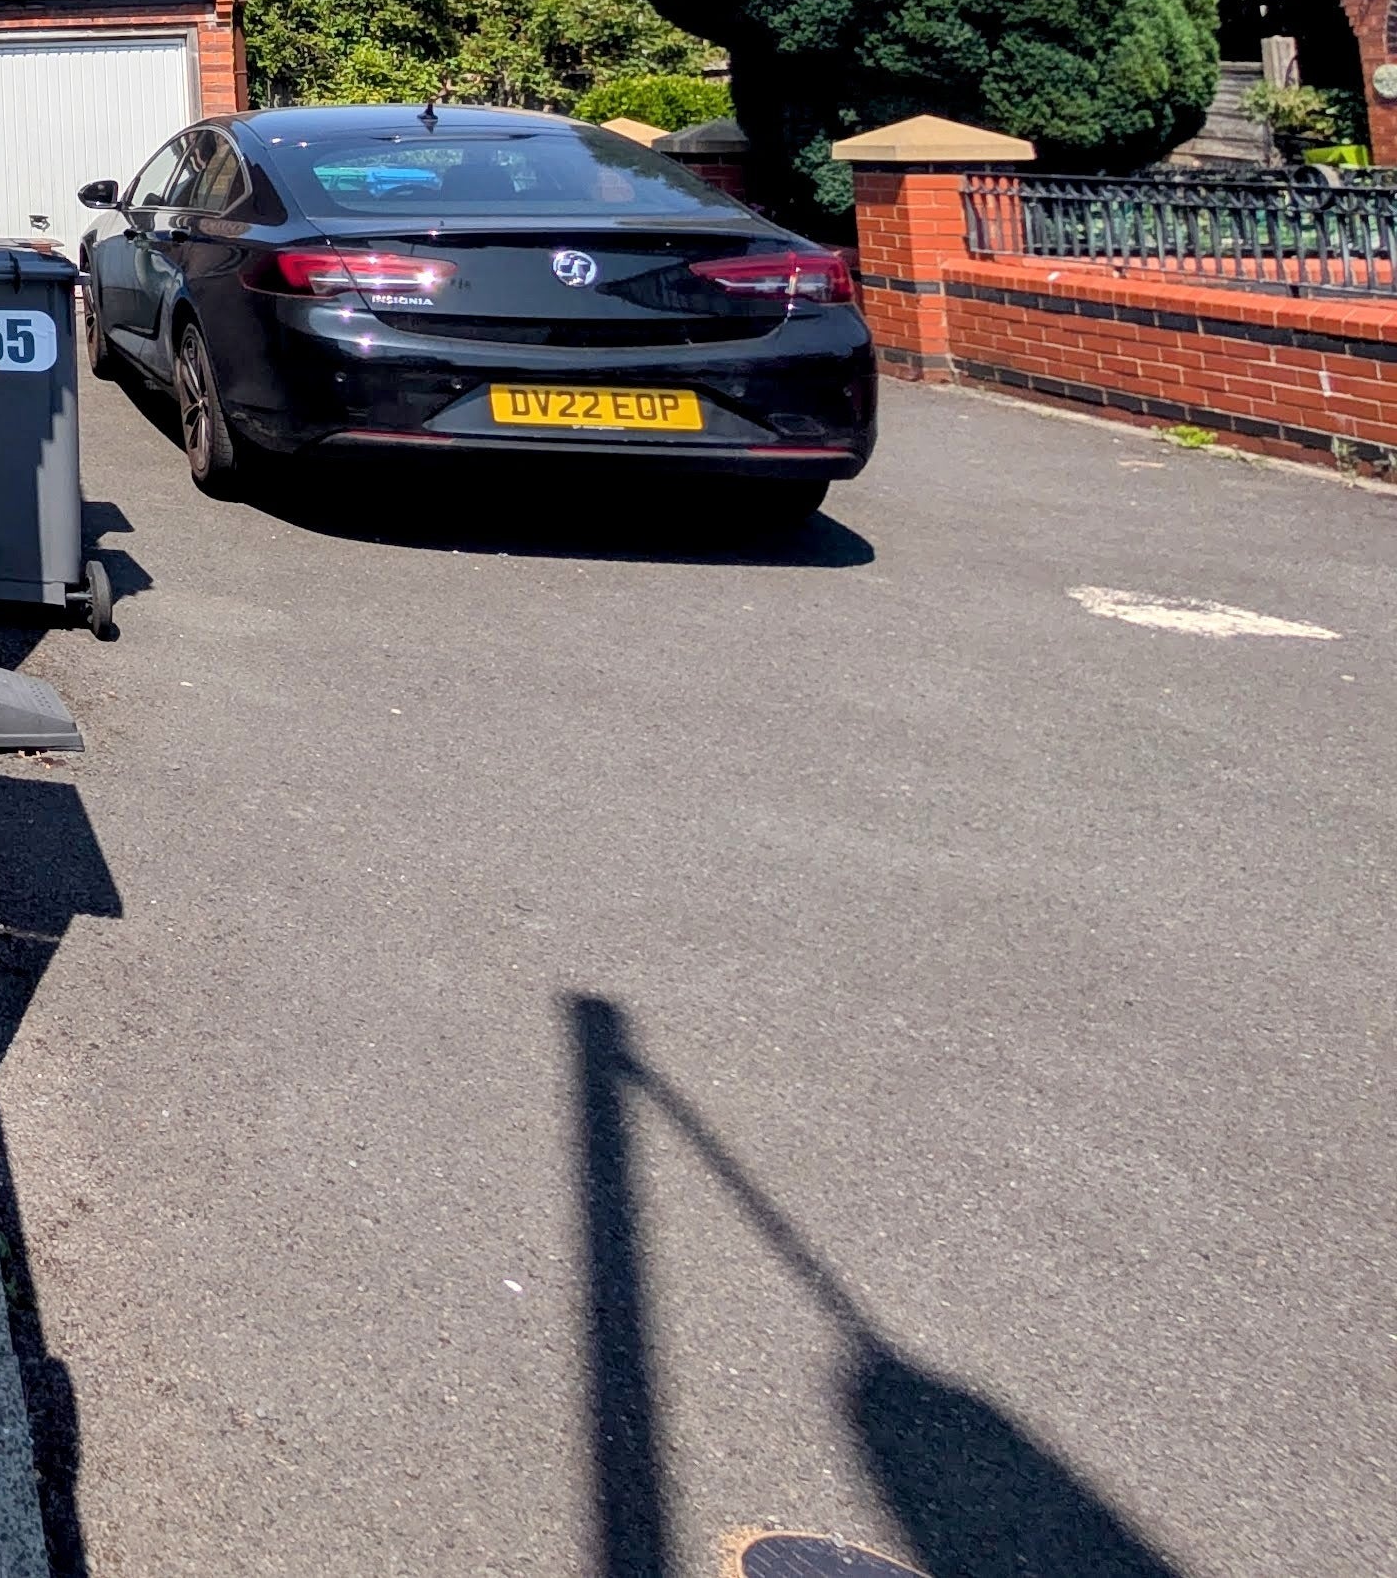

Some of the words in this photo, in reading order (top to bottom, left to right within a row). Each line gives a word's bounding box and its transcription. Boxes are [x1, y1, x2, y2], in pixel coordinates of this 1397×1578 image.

[371, 294, 434, 306] INSIGNIA
[508, 389, 603, 419] DV22
[611, 392, 680, 422] EOP
